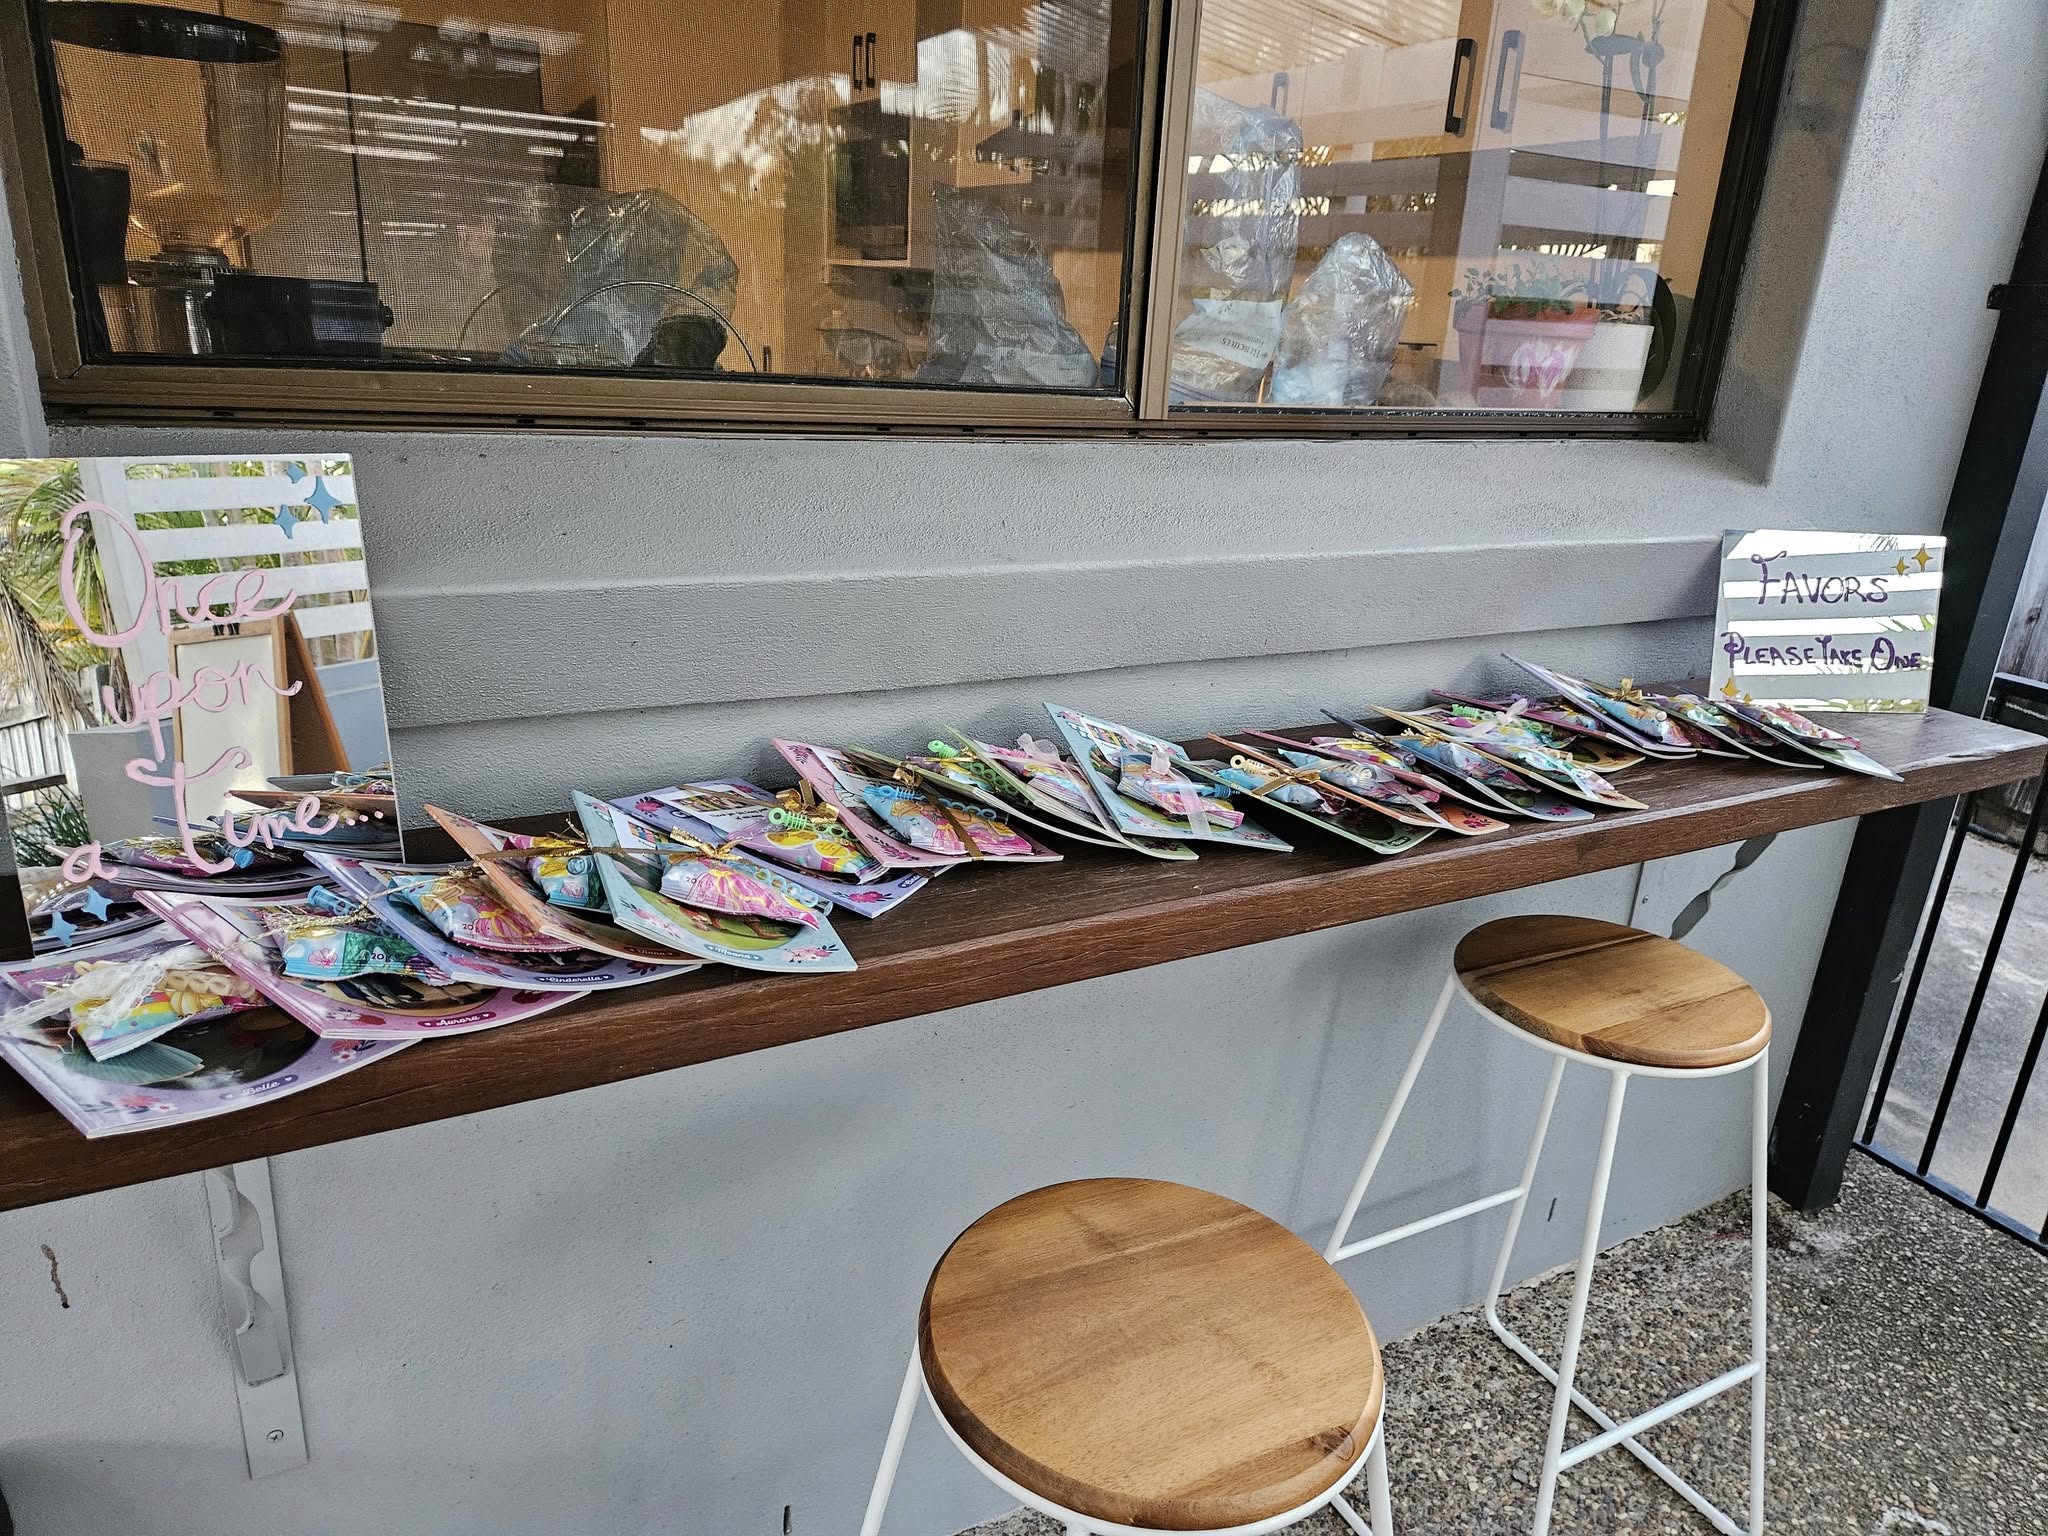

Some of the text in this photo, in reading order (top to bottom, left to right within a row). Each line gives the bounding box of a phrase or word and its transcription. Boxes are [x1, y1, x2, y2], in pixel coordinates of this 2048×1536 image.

[60, 500, 298, 648] Once
[1750, 550, 1889, 605] FAVORS
[1721, 631, 1921, 671] PLEASE TAKE ONE
[102, 659, 303, 763] upon
[62, 839, 120, 884] a
[546, 974, 603, 984] Cinderella
[436, 1014, 481, 1027] Aurora
[240, 1081, 281, 1097] Belle
